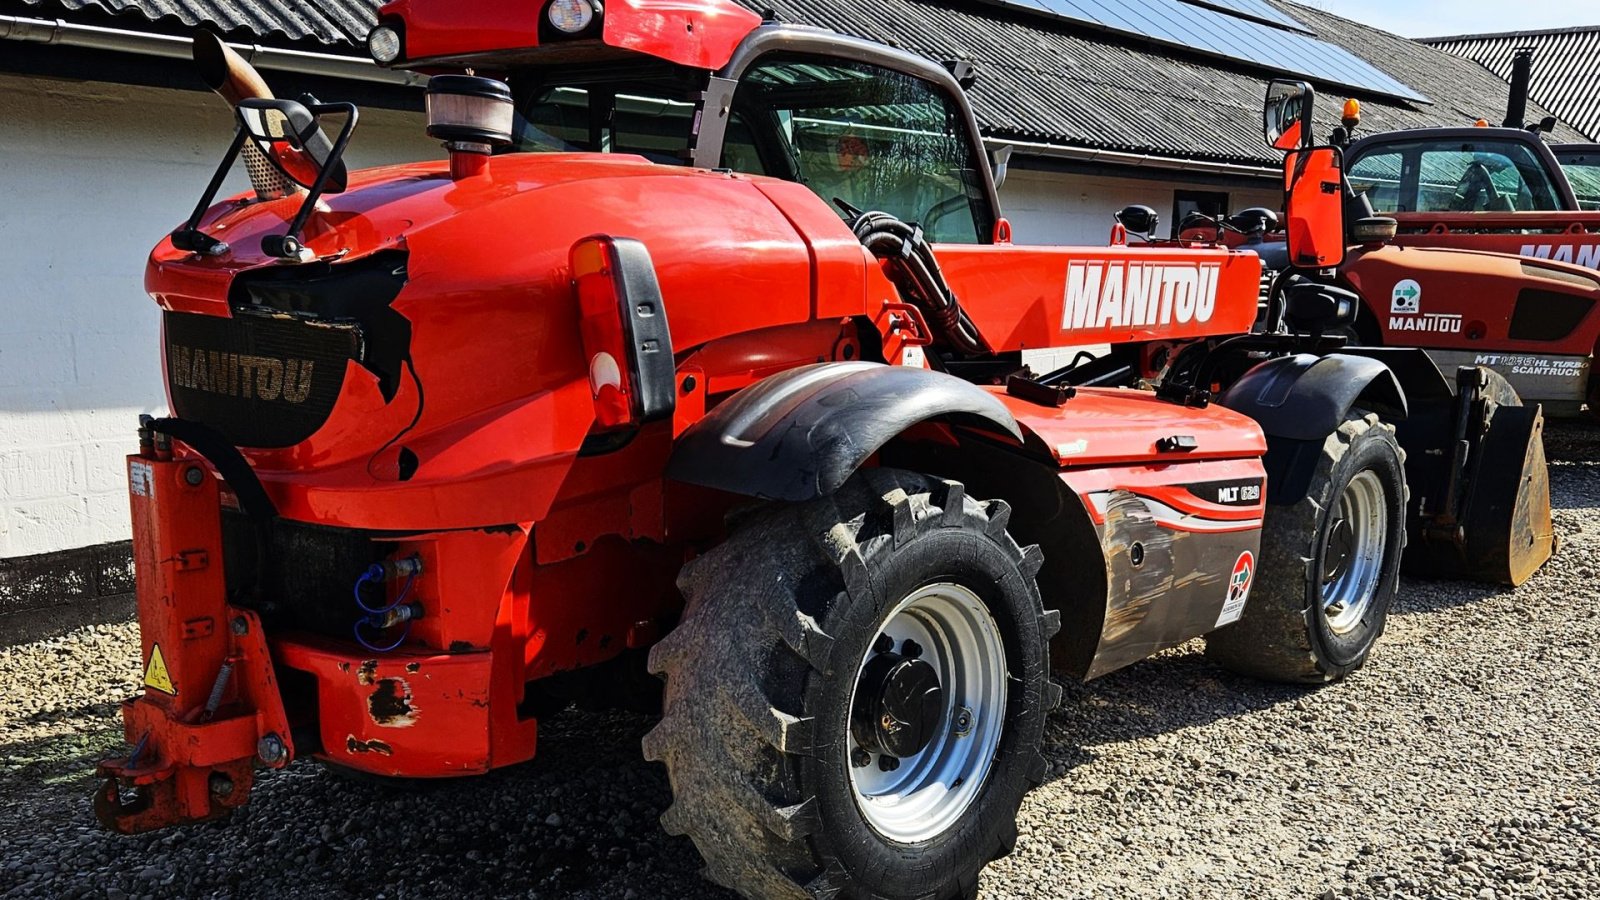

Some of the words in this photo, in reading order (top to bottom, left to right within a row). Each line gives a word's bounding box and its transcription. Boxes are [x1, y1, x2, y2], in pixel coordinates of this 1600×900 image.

[1061, 260, 1221, 331] MANITOU
[1389, 313, 1463, 333] MANITOU
[171, 344, 315, 404] MANITOU
[1511, 365, 1581, 377] SCANTRUCK
[1552, 360, 1589, 369] TURBO
[1218, 486, 1239, 503] MLT
[1241, 485, 1260, 501] 629
